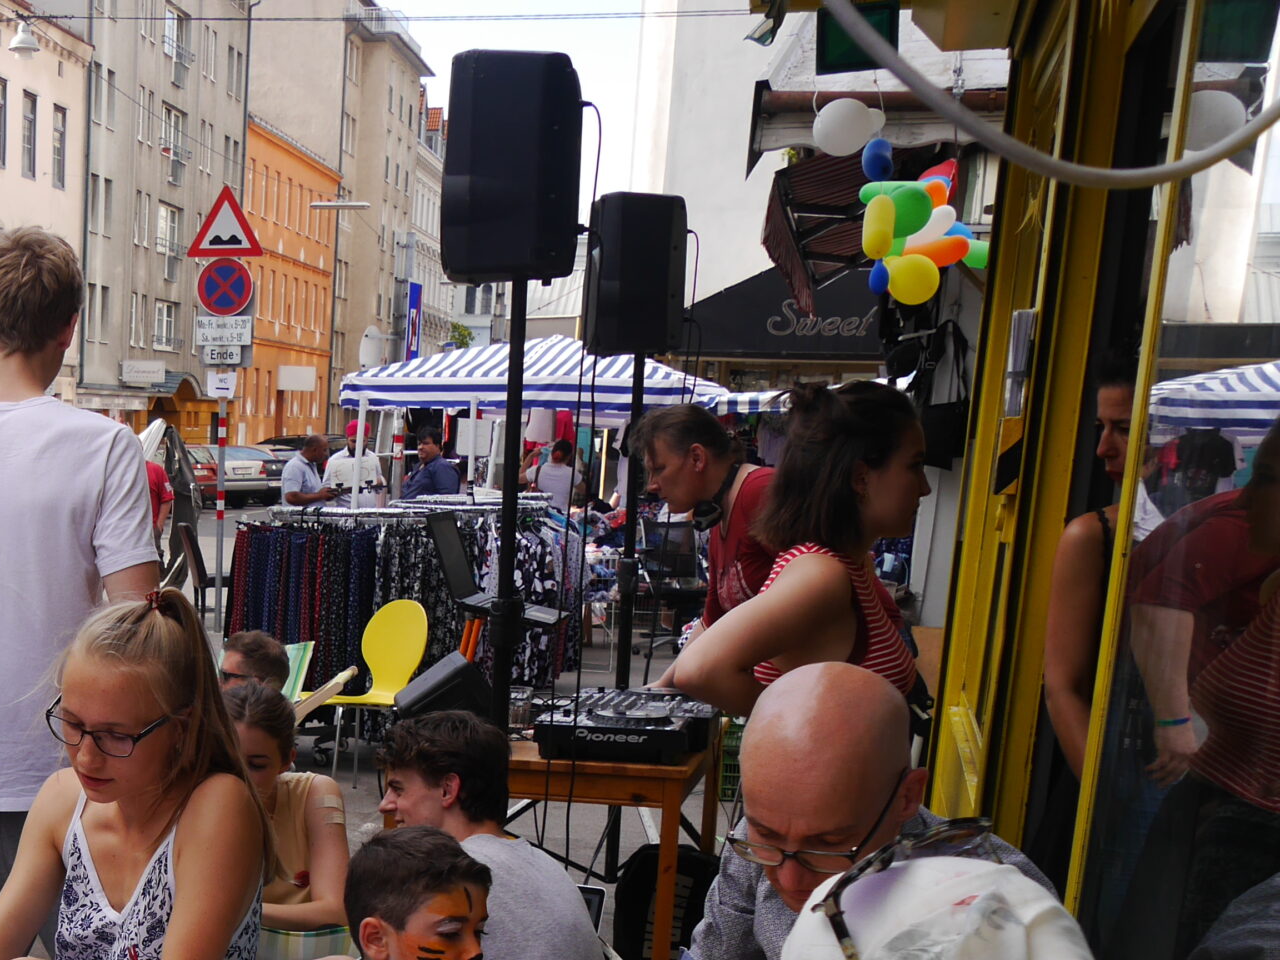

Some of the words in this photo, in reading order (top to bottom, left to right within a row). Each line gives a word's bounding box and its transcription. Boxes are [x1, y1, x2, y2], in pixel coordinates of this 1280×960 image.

[766, 299, 879, 336] Sweet
[210, 349, 234, 360] Ende
[576, 728, 648, 743] Pioneer
